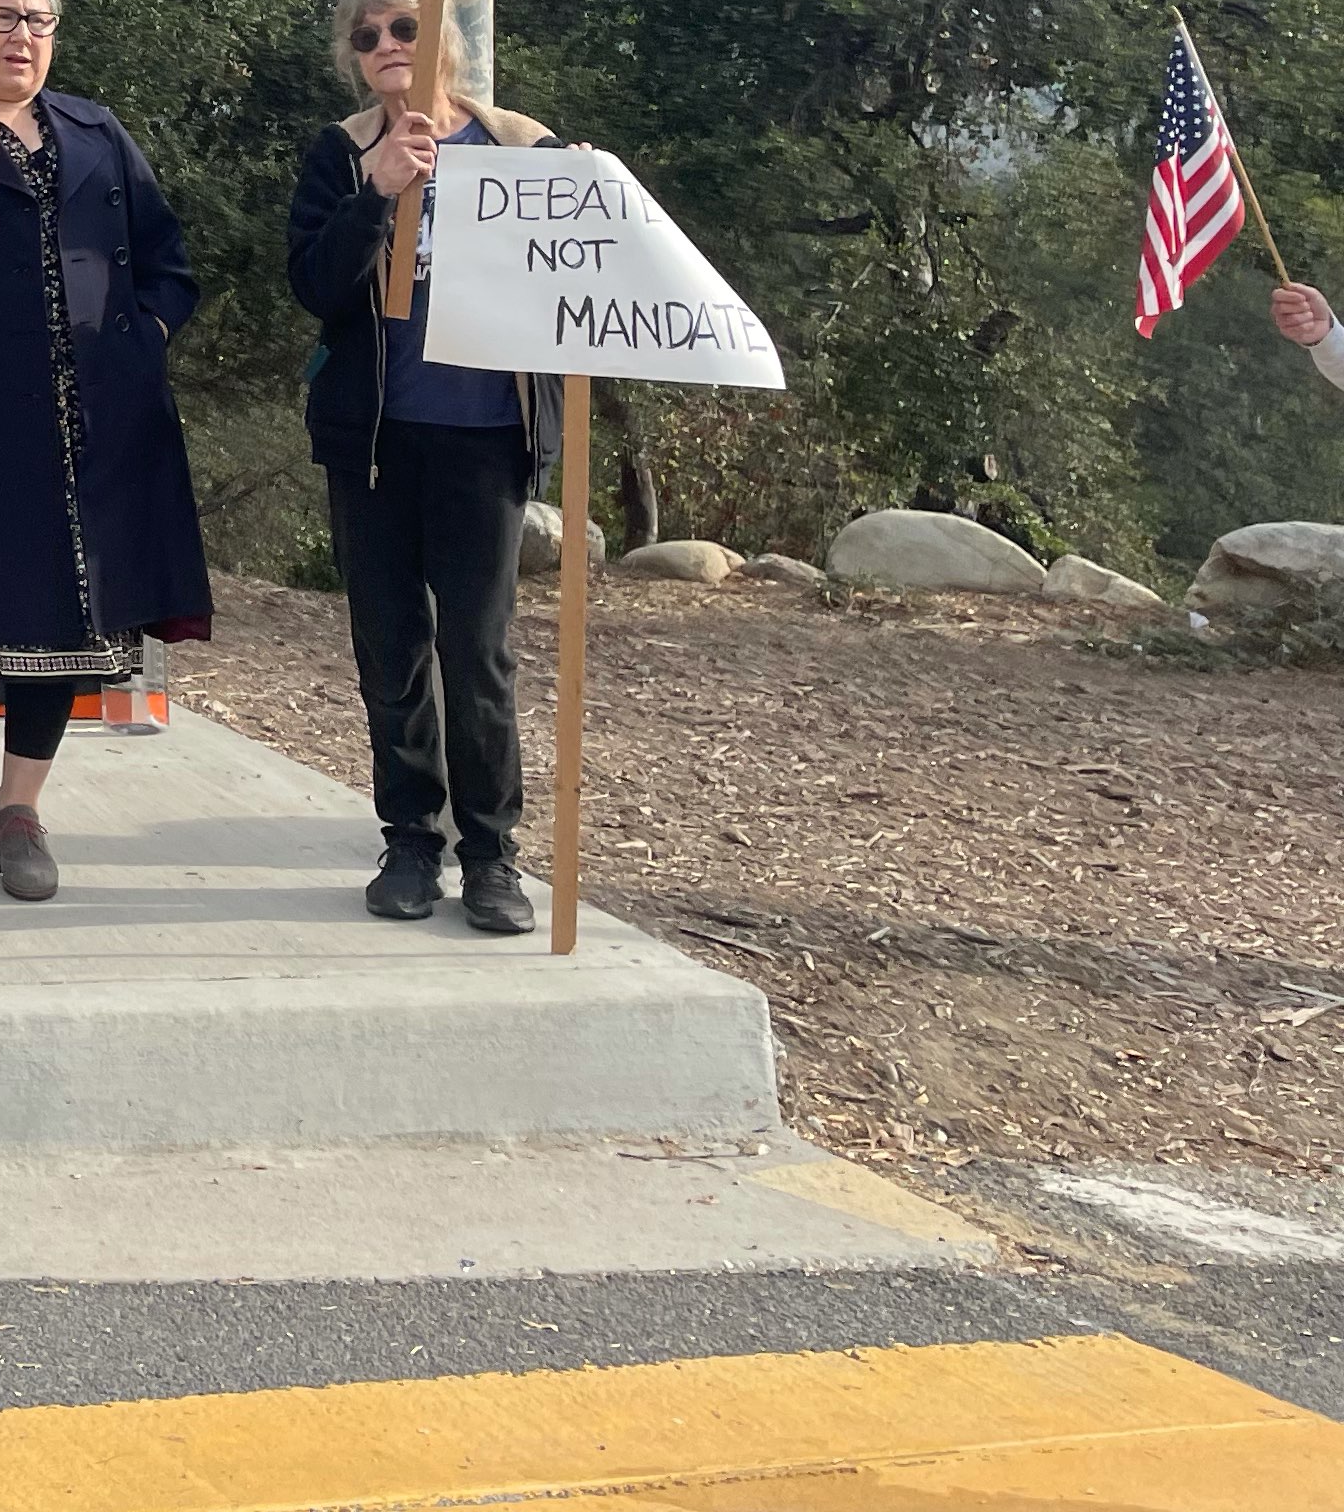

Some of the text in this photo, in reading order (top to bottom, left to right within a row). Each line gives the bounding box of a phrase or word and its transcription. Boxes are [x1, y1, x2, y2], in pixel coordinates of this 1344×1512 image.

[477, 177, 663, 224] DEBATE
[528, 238, 619, 273] NOT
[556, 295, 768, 353] MANDATE
